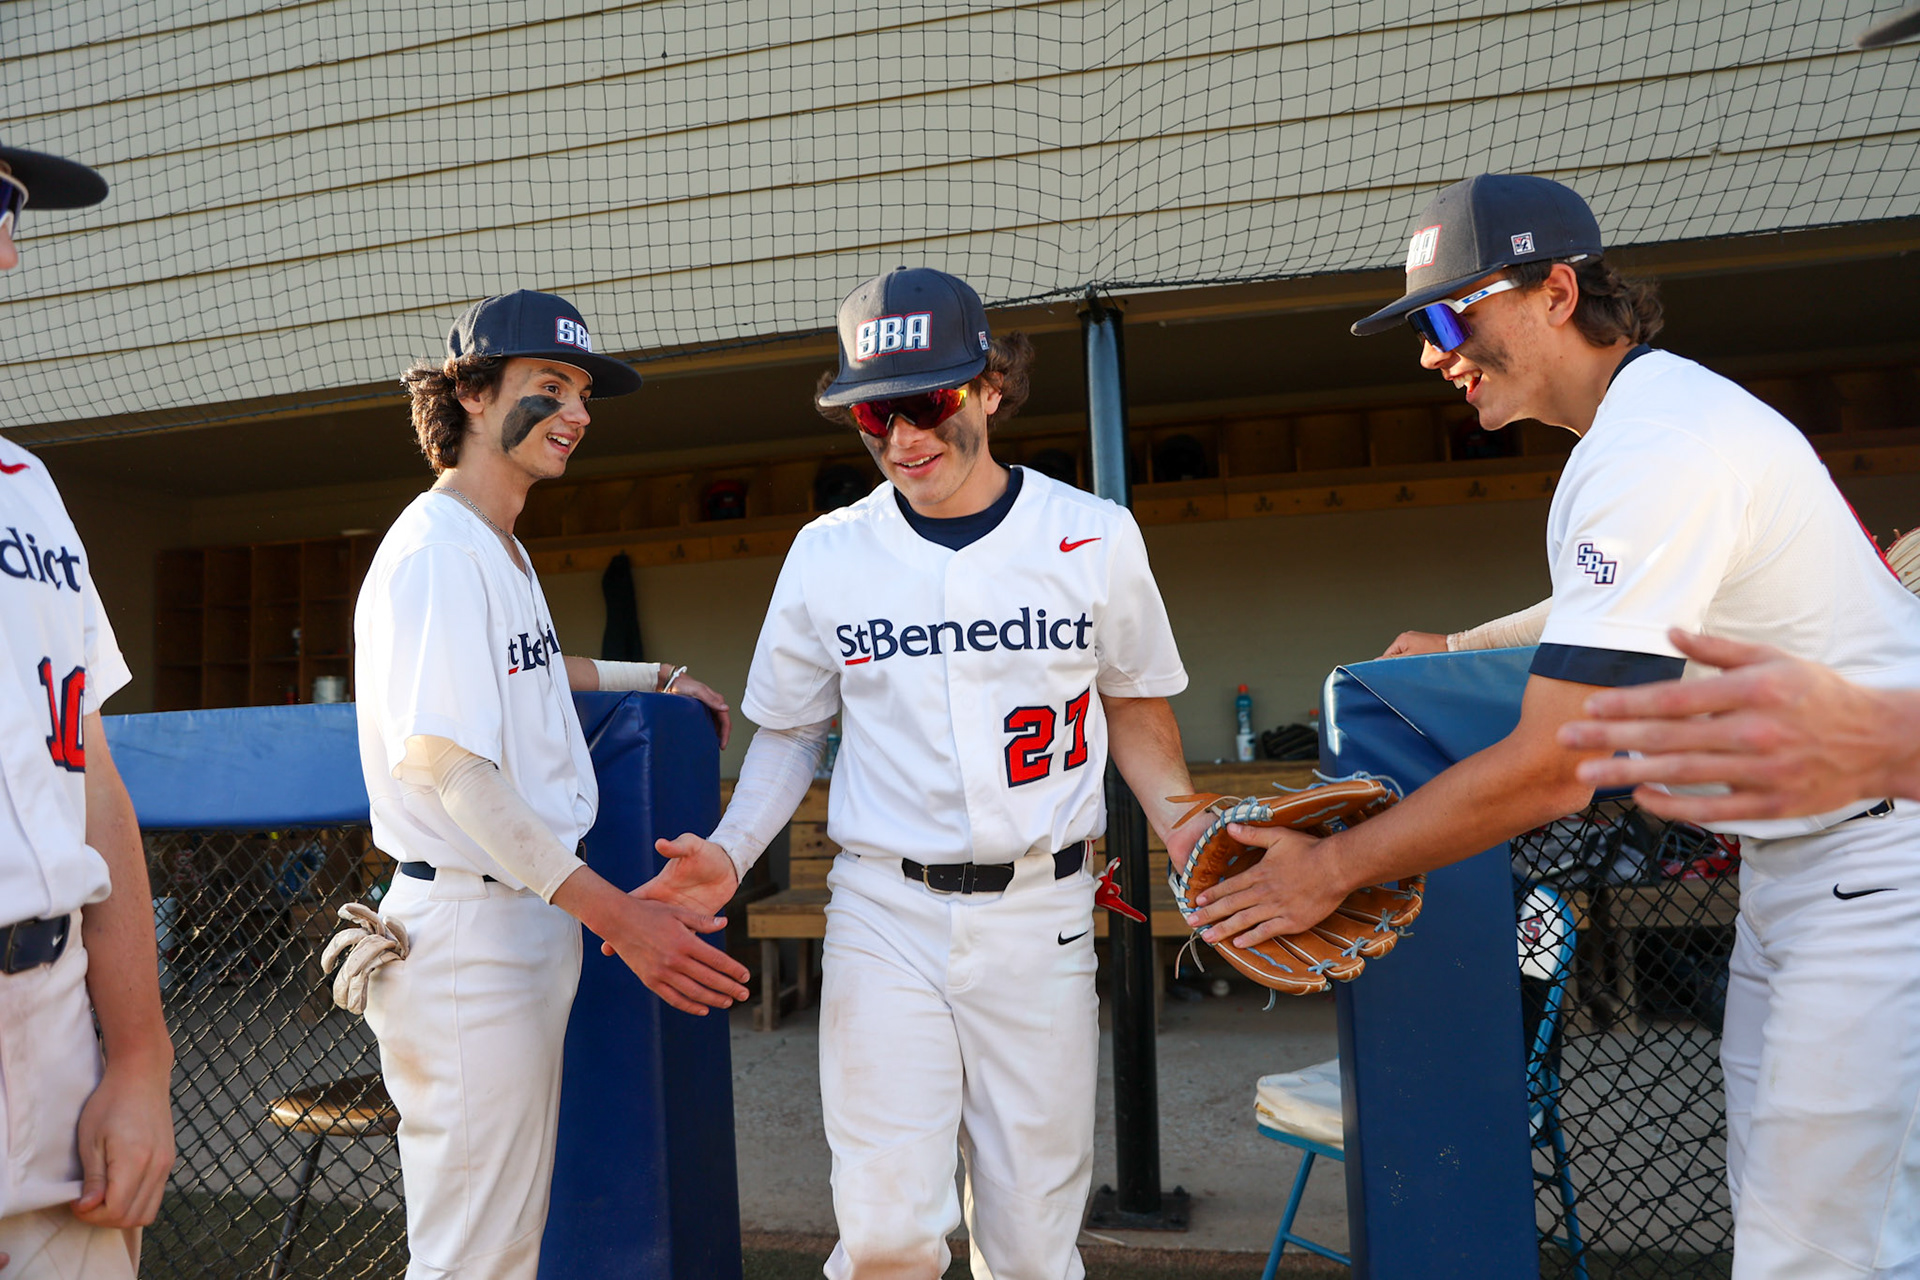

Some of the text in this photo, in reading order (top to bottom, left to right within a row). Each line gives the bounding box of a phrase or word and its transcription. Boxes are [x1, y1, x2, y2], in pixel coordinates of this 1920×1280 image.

[857, 312, 932, 361] SBA
[1577, 543, 1617, 585] SBA
[37, 656, 86, 773] 10
[1003, 687, 1090, 788] 27
